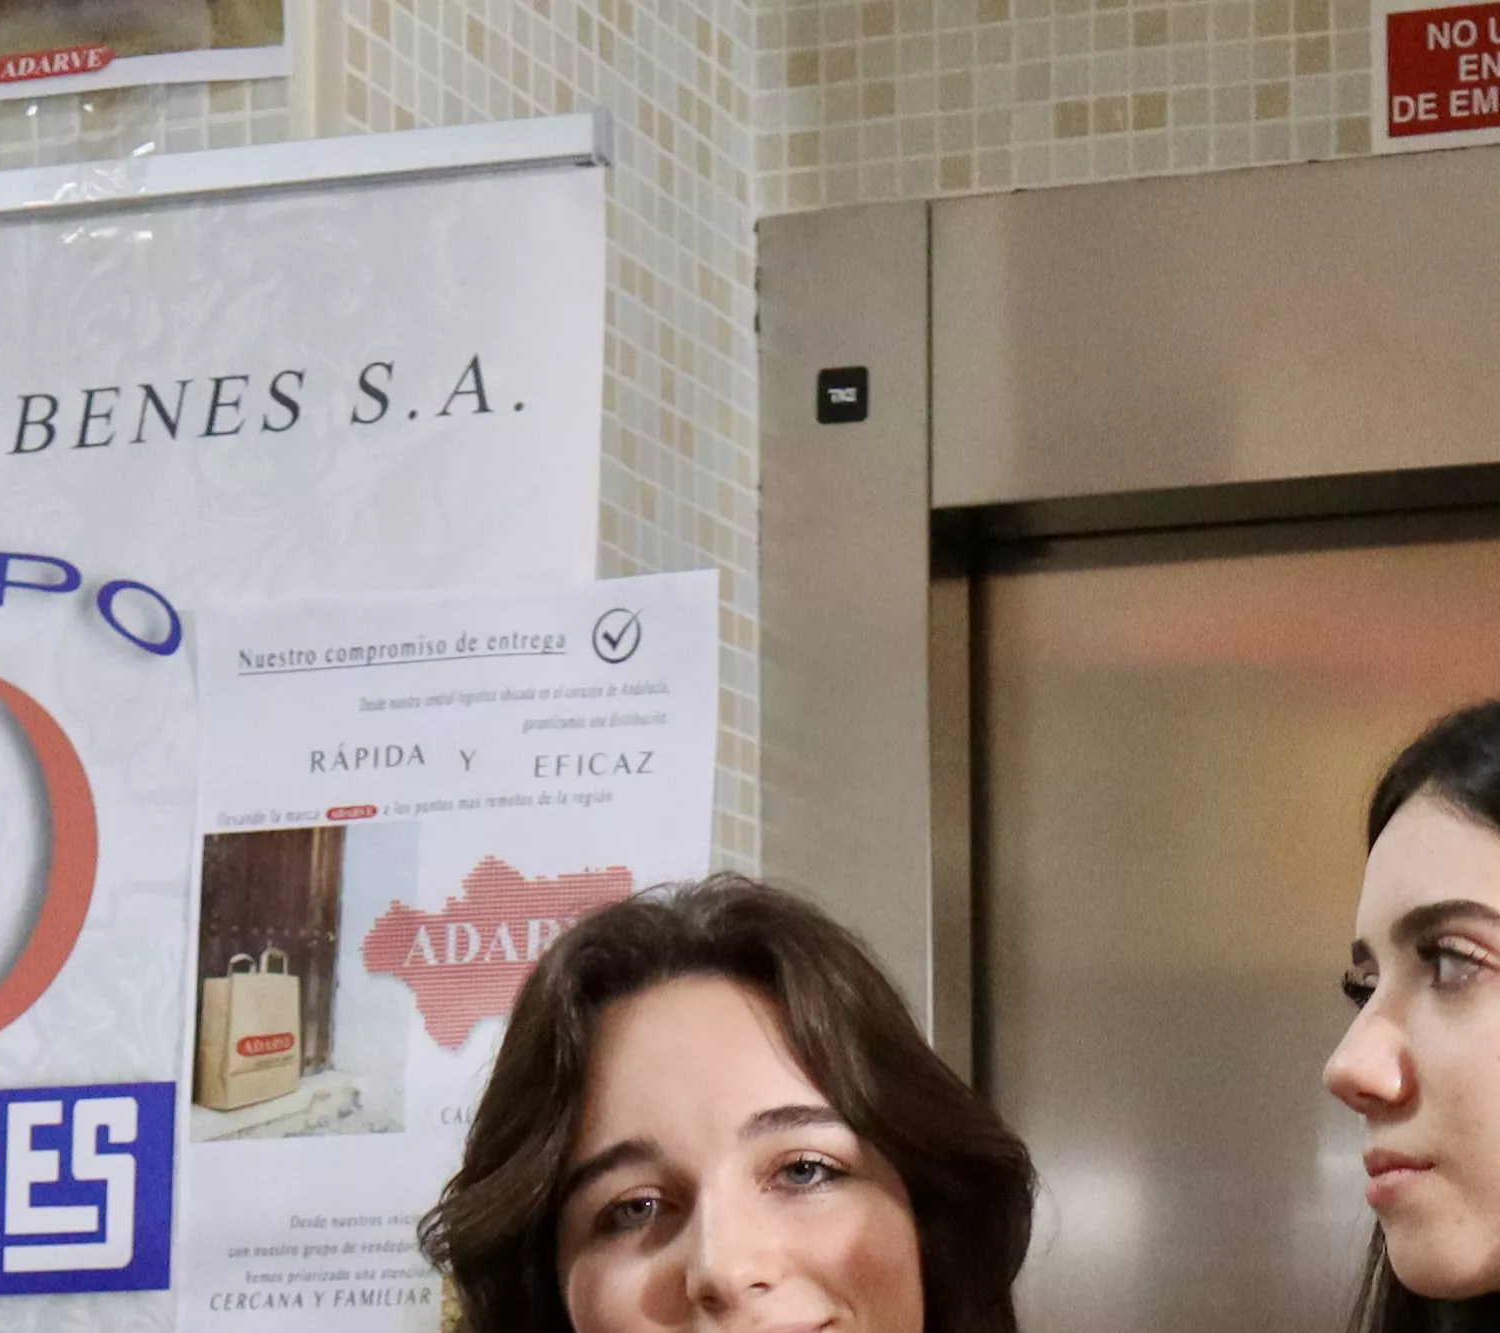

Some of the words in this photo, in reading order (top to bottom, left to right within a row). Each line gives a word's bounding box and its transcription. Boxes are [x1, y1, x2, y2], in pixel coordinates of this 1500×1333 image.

[1427, 18, 1477, 51] NO
[2, 47, 102, 79] ADARVE
[1393, 92, 1438, 123] DE
[350, 353, 526, 428] S.A.
[238, 644, 317, 670] Nuestro
[324, 633, 447, 667] compromiso
[455, 631, 479, 653] de
[486, 630, 566, 655] entrega
[310, 742, 426, 774] RÁPIDA
[460, 748, 478, 771] Y
[533, 751, 656, 778] EFICAZ
[402, 918, 577, 967] ADAR
[290, 1214, 328, 1229] Desde
[209, 1291, 303, 1312] CERCANA
[313, 1289, 327, 1308] Y
[333, 1287, 432, 1308] FAMILIAR
